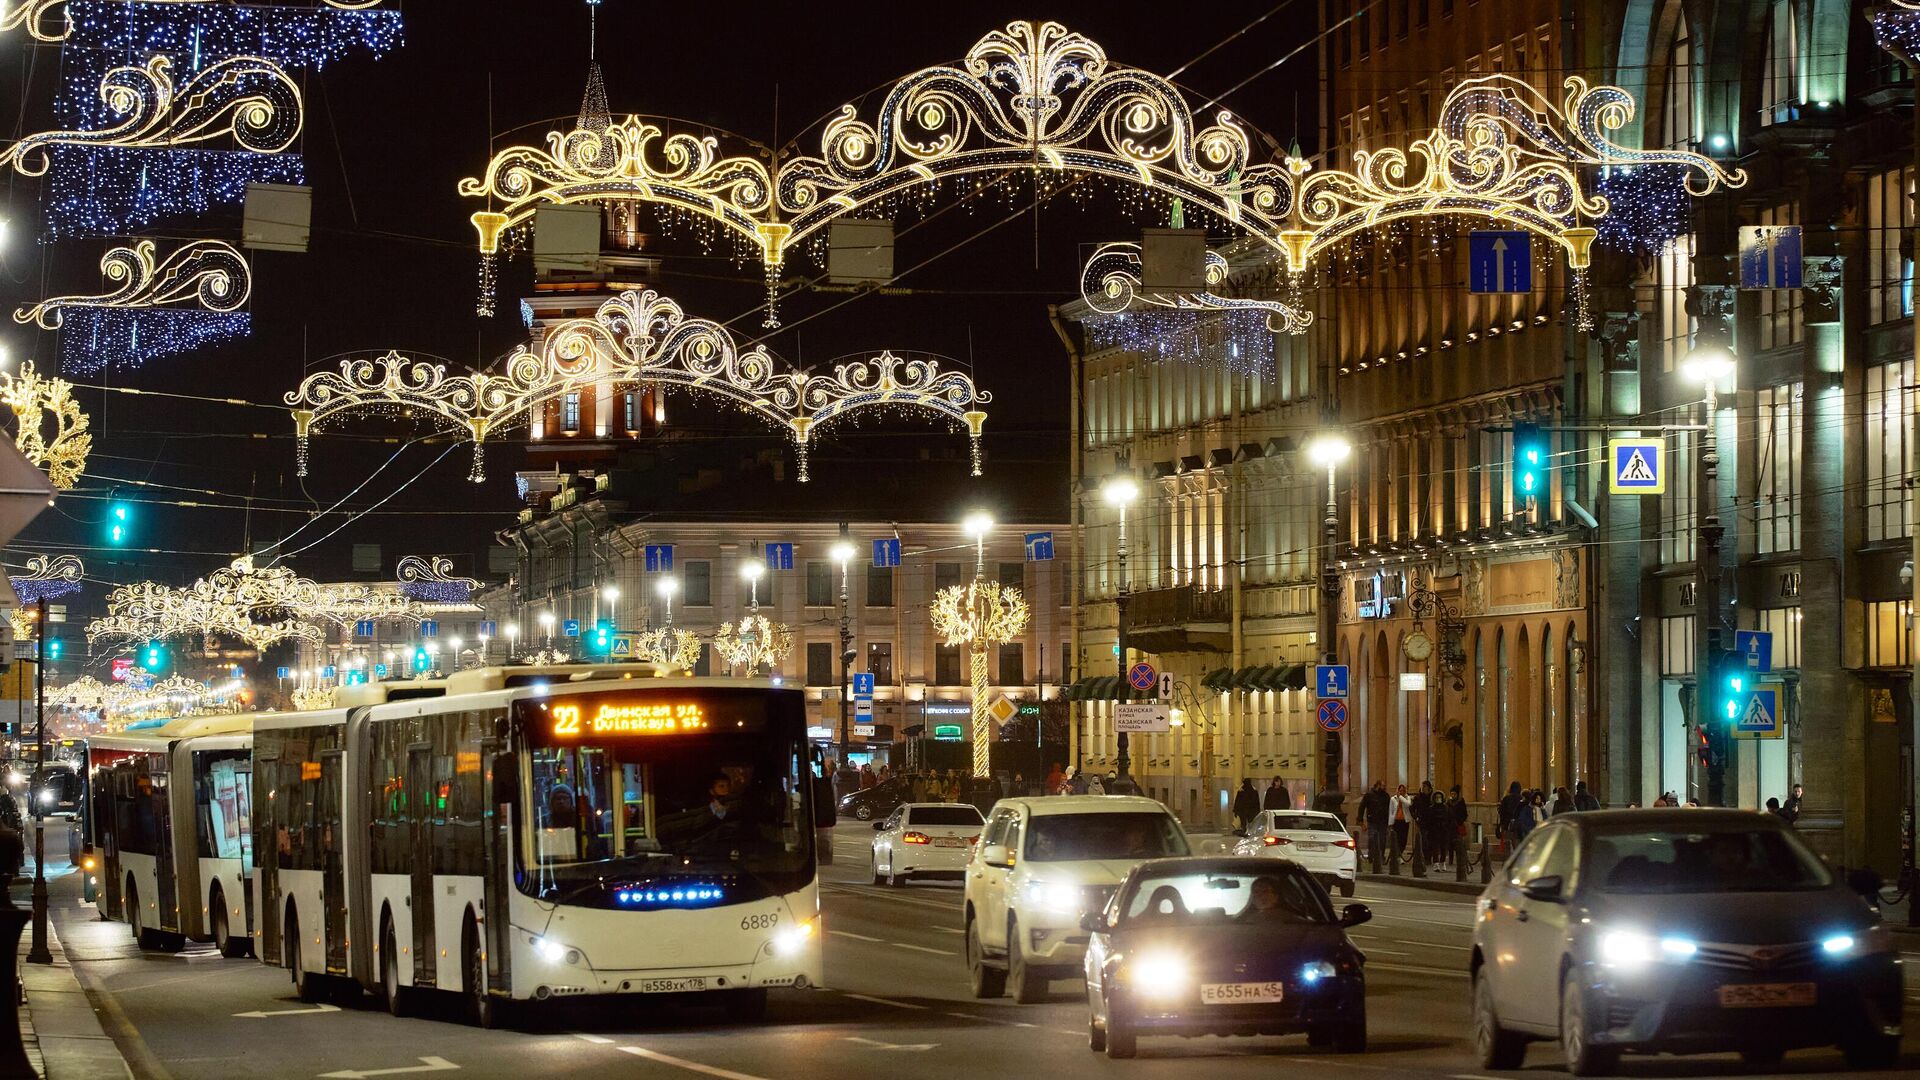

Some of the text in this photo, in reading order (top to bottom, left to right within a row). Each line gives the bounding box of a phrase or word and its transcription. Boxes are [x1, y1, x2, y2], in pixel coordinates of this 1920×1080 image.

[600, 704, 703, 718] Двинская ул.
[553, 705, 580, 734] 22
[594, 716, 708, 731] Dvinskaya st.
[741, 913, 778, 931] 6889
[645, 981, 686, 991] В558ХК
[1207, 985, 1261, 998] Е655НА
